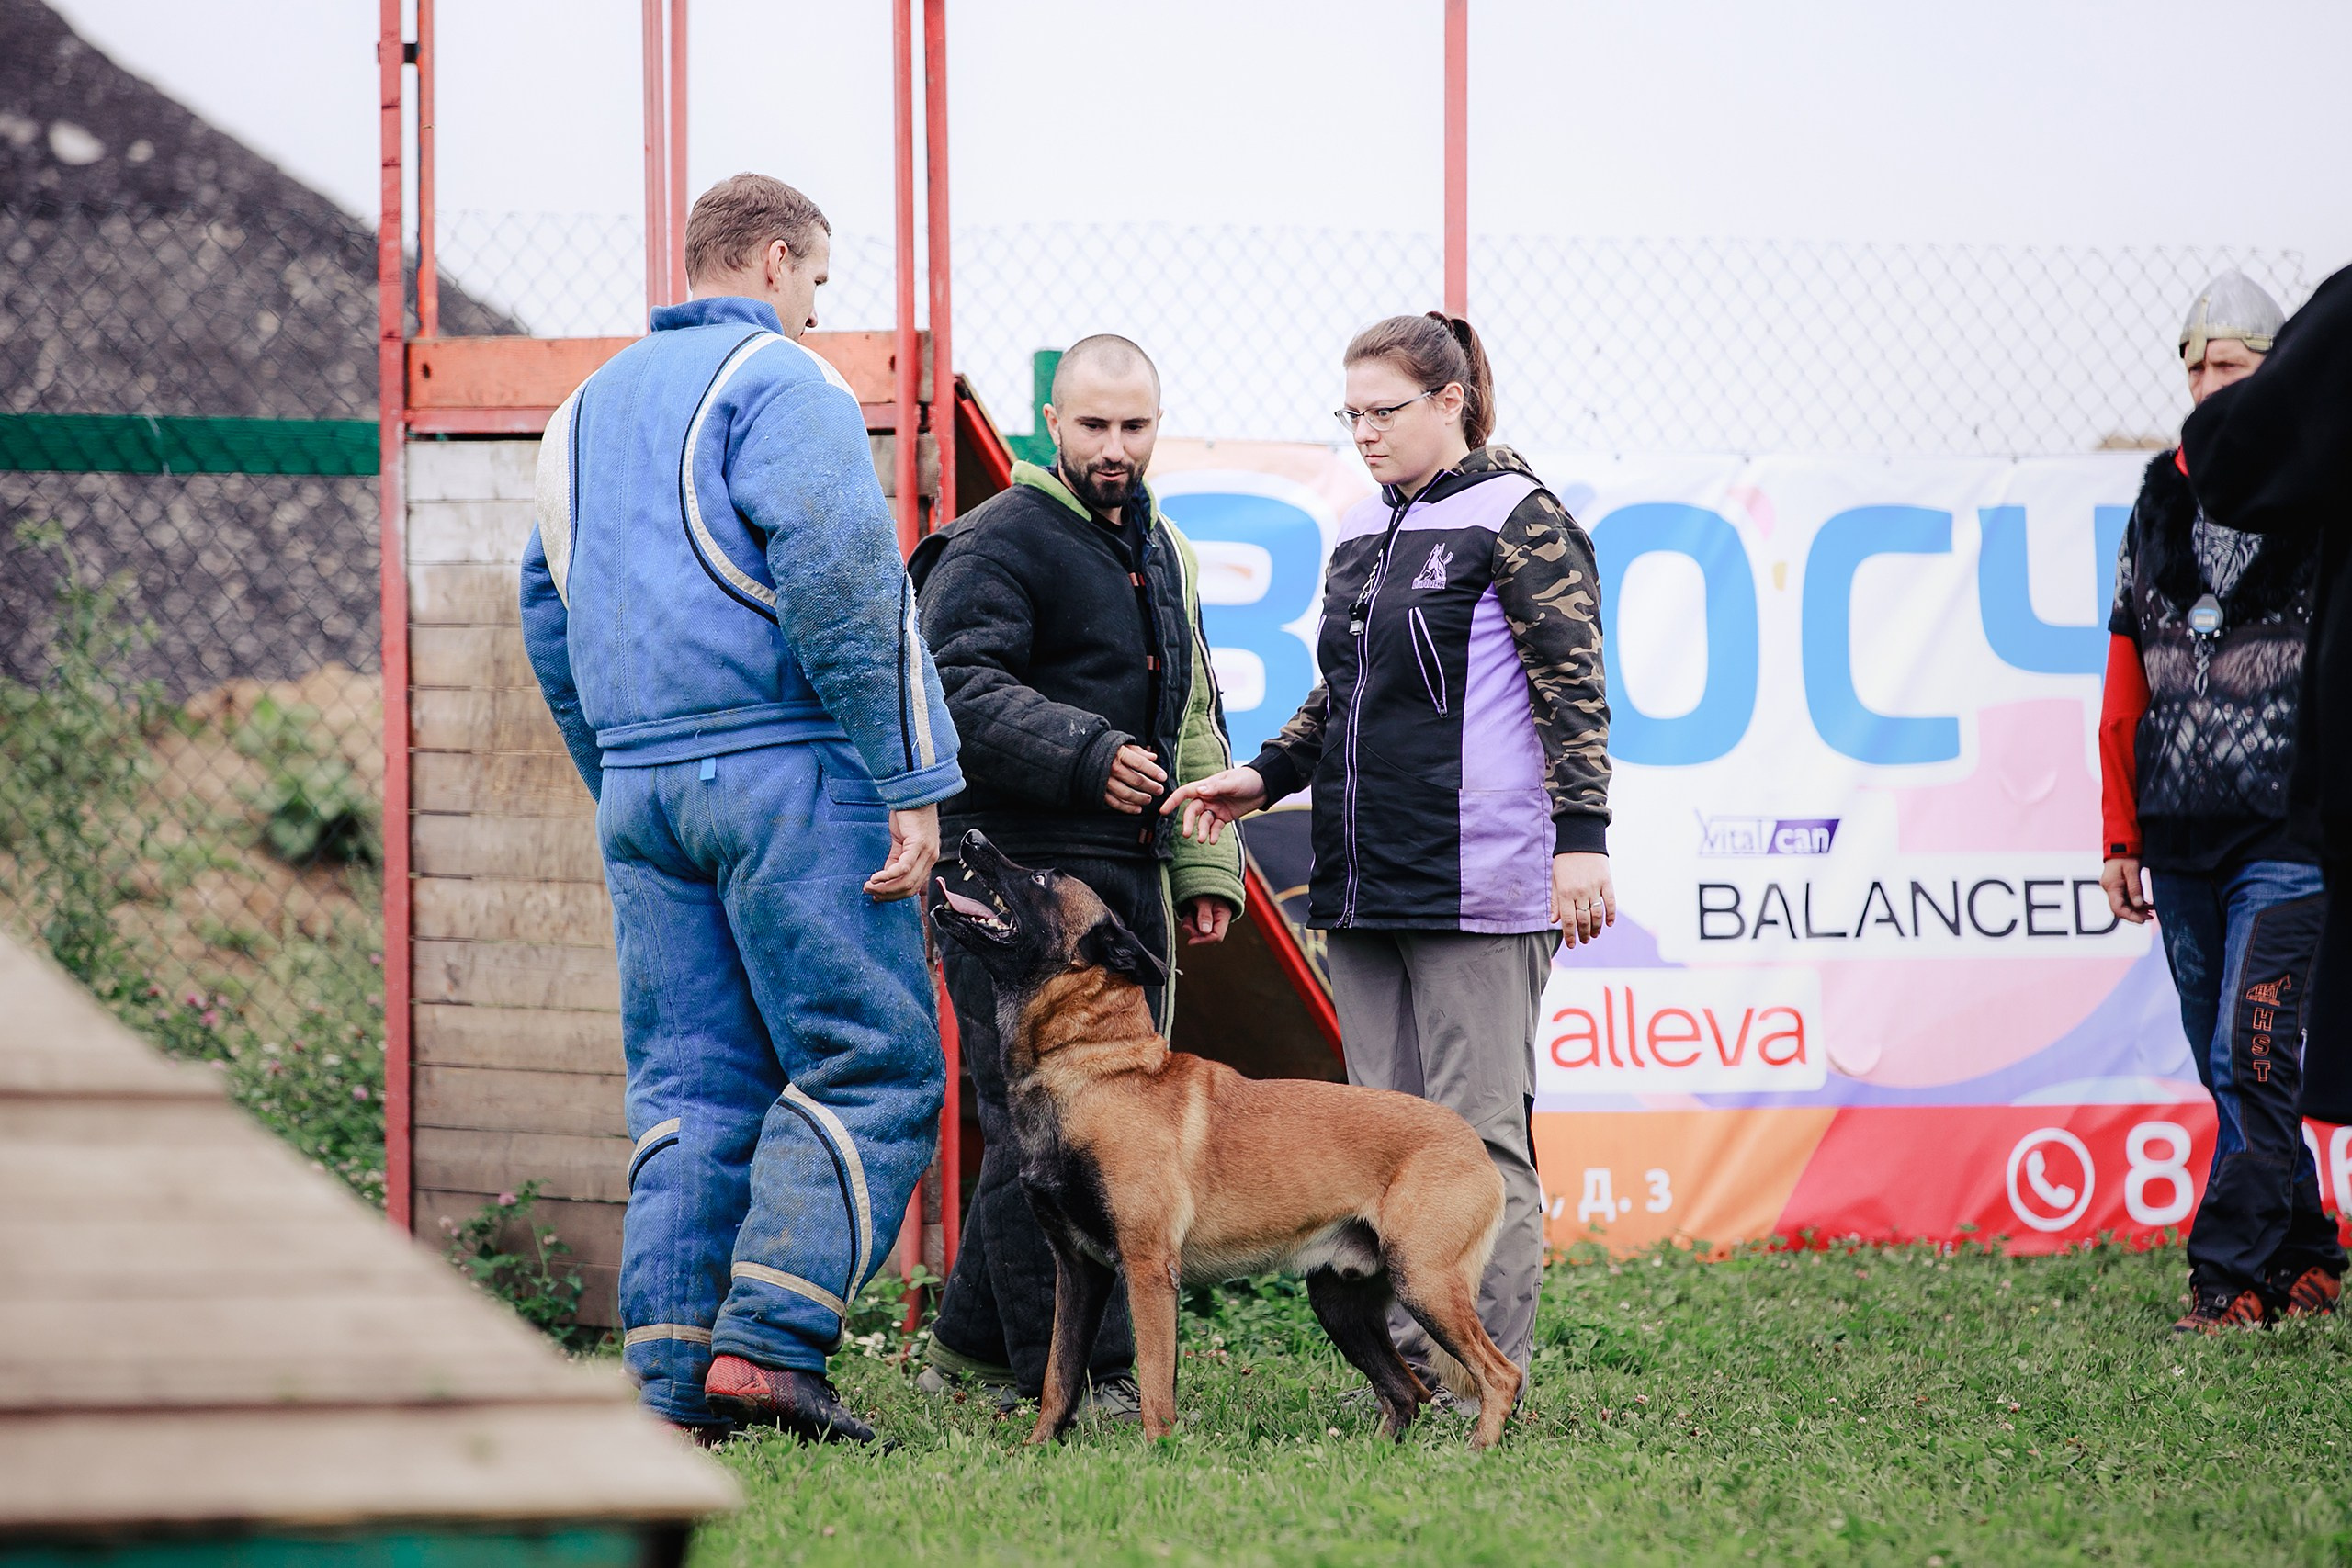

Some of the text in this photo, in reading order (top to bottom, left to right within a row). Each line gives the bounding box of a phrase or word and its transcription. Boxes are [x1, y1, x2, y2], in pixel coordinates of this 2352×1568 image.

[1698, 879, 2119, 941] BALANCED
[1550, 985, 1807, 1068] alleva
[2251, 1007, 2274, 1082] HST
